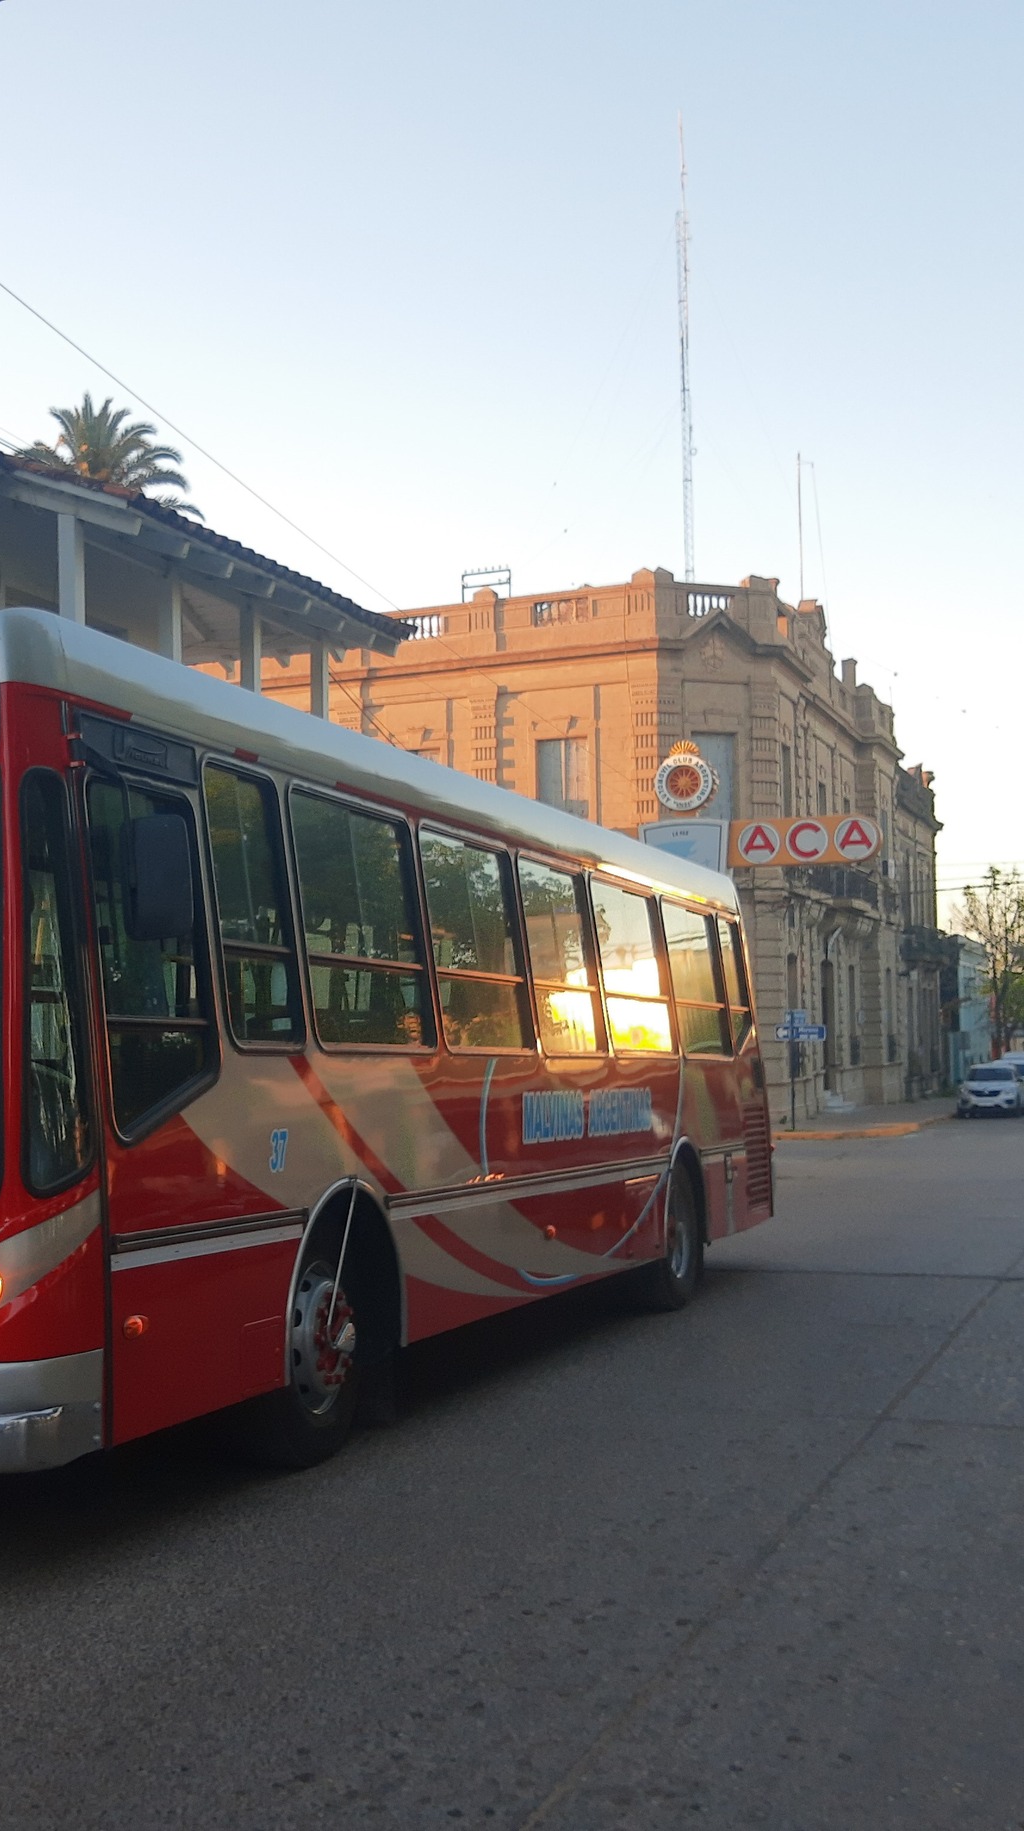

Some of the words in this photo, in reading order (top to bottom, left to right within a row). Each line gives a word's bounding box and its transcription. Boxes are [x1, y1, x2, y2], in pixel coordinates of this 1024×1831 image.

[744, 819, 873, 859] ACA
[522, 1090, 585, 1145] MALVINAS
[588, 1086, 652, 1137] ARGENTINAS
[268, 1127, 289, 1174] 37
